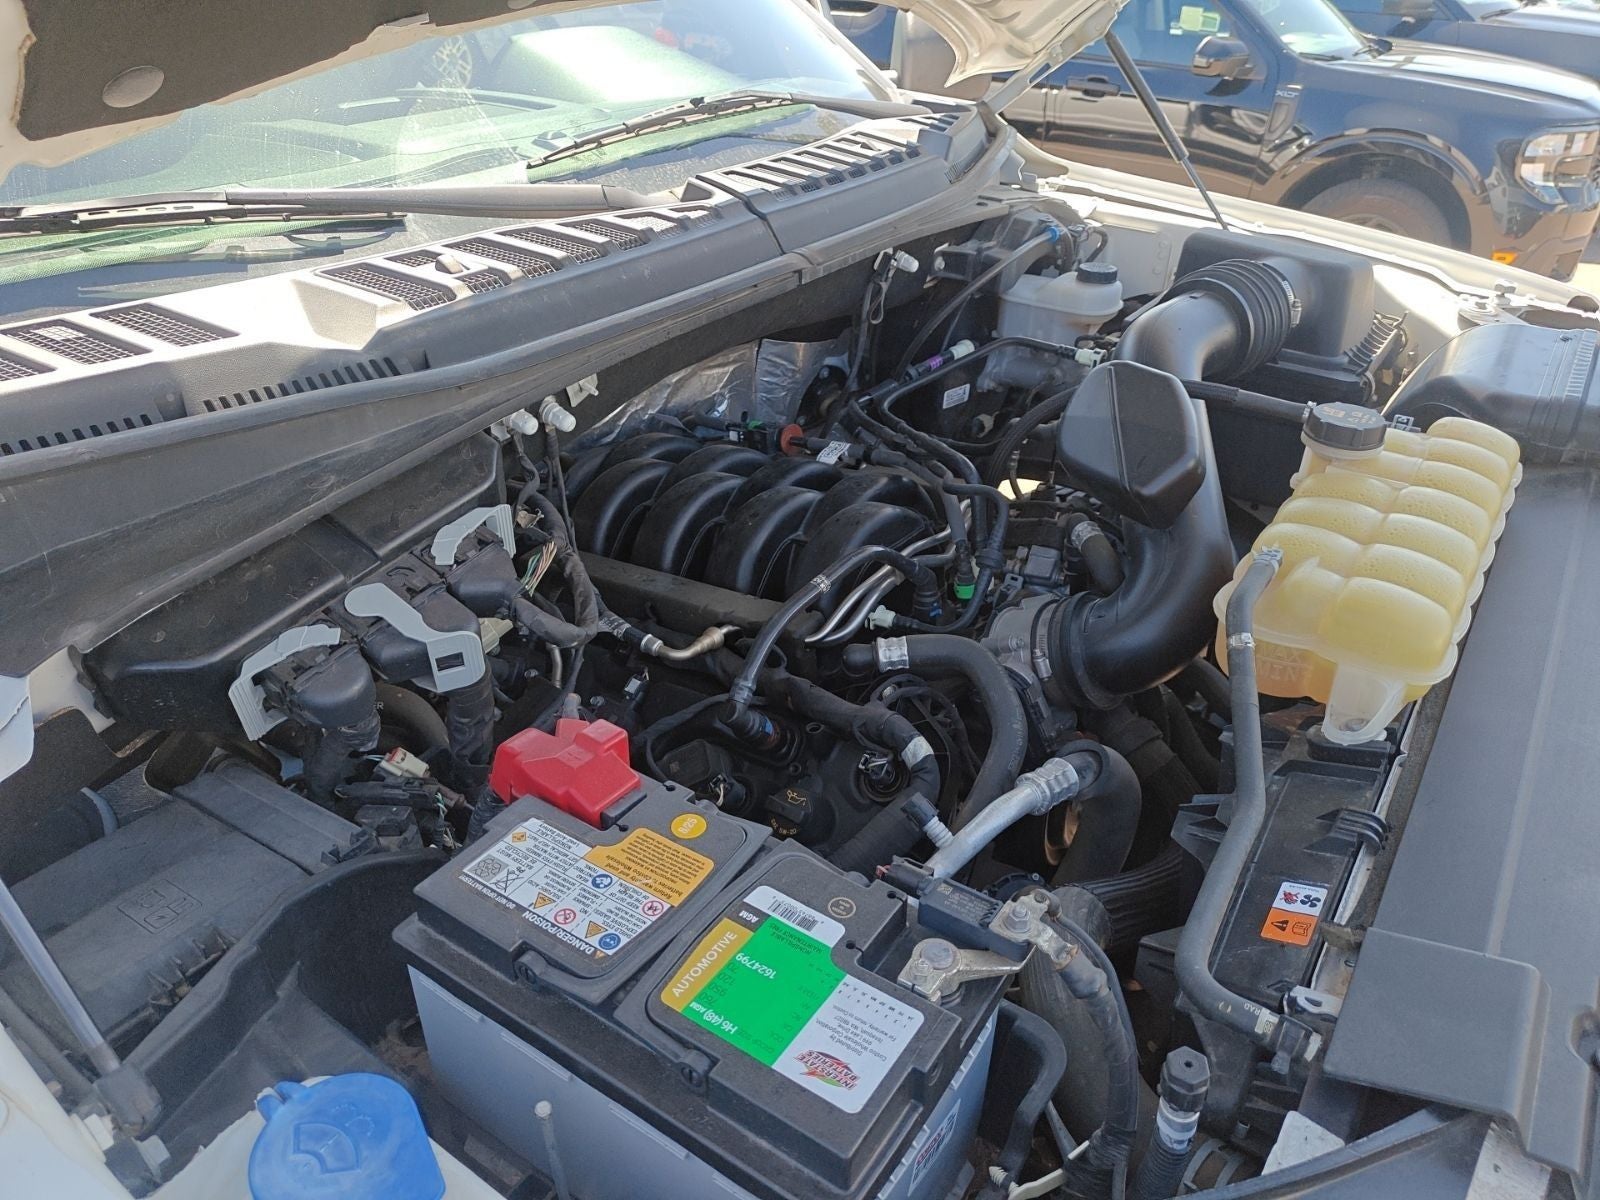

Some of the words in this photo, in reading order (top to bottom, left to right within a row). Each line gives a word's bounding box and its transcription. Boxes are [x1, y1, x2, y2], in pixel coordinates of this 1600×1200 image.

[1275, 90, 1300, 99] XLT
[538, 824, 555, 834] Battery
[536, 830, 571, 848] NONSPILLABLE
[497, 848, 512, 857] MUST
[503, 845, 529, 860] RECYCLED
[546, 851, 559, 859] WITH
[550, 846, 568, 857] MEDICAL
[511, 856, 533, 869] BATTERY
[552, 862, 566, 870] FLUSH
[559, 858, 572, 866] ATELY
[604, 855, 631, 869] Wholesale
[604, 863, 618, 871] used
[575, 874, 589, 882] READ
[632, 869, 650, 880] Costco
[527, 879, 539, 887] ACID
[657, 882, 682, 895] batteries
[481, 887, 496, 897] OPEN
[538, 886, 560, 899] SULFURIC
[580, 887, 599, 898] SMOKING
[617, 889, 633, 898] REACH
[652, 887, 671, 898] Return
[495, 895, 507, 903] NOT
[572, 897, 590, 907] SPARKS
[626, 901, 639, 909] KEEP
[738, 910, 760, 923] AGM
[611, 918, 637, 933] EXPLOSIVE
[522, 911, 594, 953] DANGER/POISON
[614, 927, 632, 938] SHIELD
[672, 931, 738, 998] AUTOMOTIVE
[735, 952, 776, 979] 1624799
[717, 971, 735, 985] 120
[708, 982, 727, 996] 950
[690, 1001, 705, 1013] AGM
[1244, 1002, 1261, 1016] RAD
[702, 1009, 723, 1025] (48)
[720, 1020, 737, 1034] H6
[850, 1031, 861, 1039] Lake
[835, 1038, 861, 1055] Distributed
[843, 1034, 867, 1051] Wholesale
[868, 1048, 886, 1060] Costco
[797, 1053, 857, 1090] INTERSTATE
[806, 1049, 857, 1082] BATTERIES
